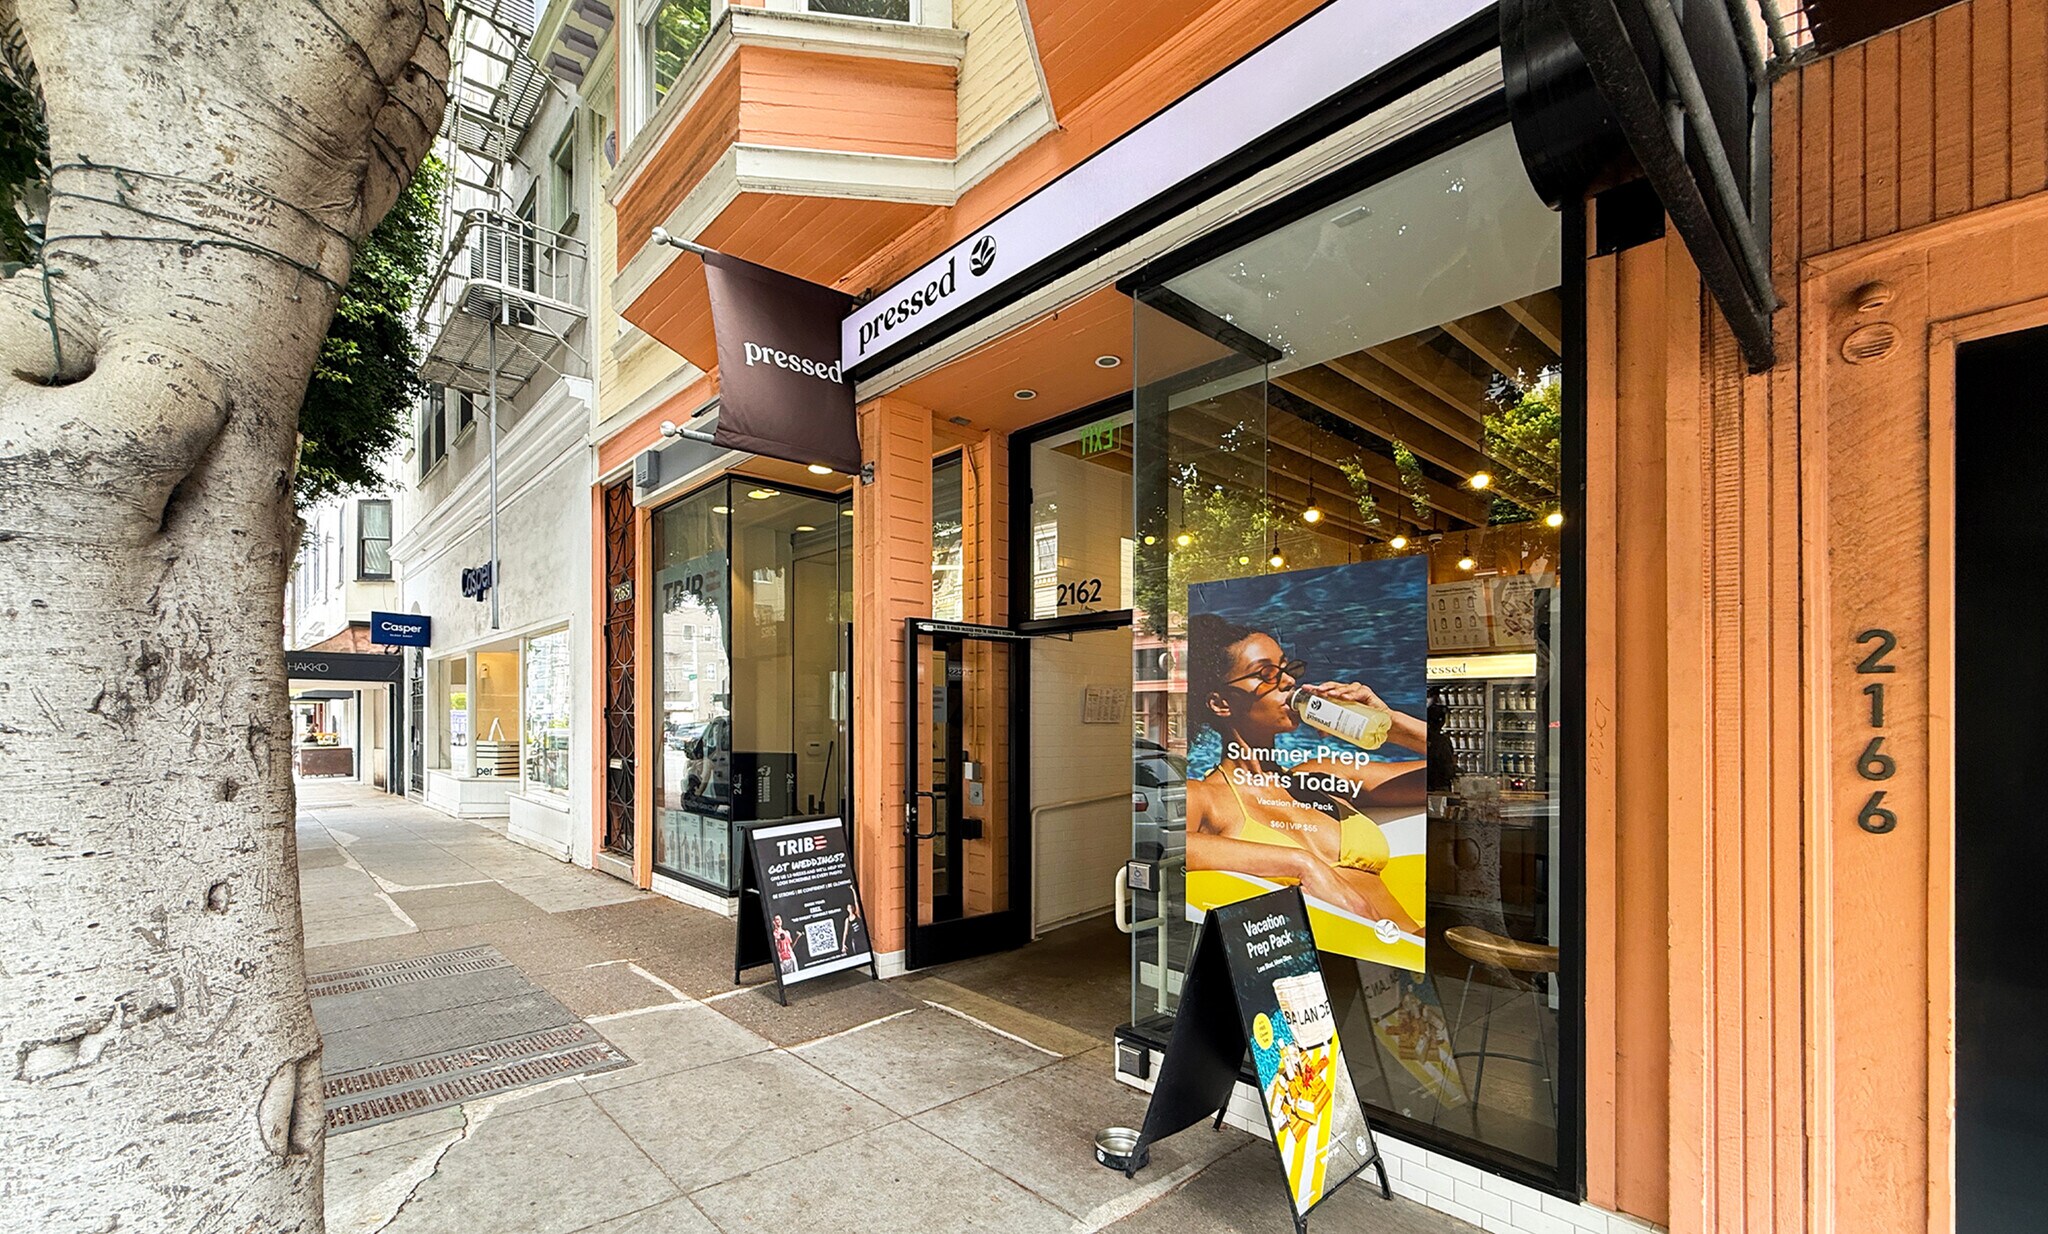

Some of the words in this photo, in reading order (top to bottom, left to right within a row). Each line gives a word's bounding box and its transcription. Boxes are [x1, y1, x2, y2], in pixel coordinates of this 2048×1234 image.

[859, 256, 956, 356] pressed
[743, 342, 843, 384] pressed
[1056, 578, 1102, 607] 2162
[381, 621, 422, 634] Casper
[287, 661, 329, 673] HAKKO
[1427, 663, 1466, 674] ressed
[1856, 628, 1898, 835] 2166
[1227, 742, 1313, 761] Summer
[1317, 745, 1370, 770] Prep
[477, 767, 493, 778] per
[1233, 767, 1292, 789] Starts
[1295, 772, 1363, 798] Today
[1256, 796, 1291, 807] Vacation
[1292, 800, 1311, 810] Prep
[1312, 801, 1334, 812] Pack
[1270, 820, 1285, 829] $60
[1290, 822, 1302, 831] VIP
[1302, 823, 1318, 832] $55
[776, 835, 827, 857] TRIBE
[768, 862, 790, 875] GOT
[791, 852, 845, 870] WEDDINGS?
[1243, 914, 1286, 937] Vacation
[1246, 941, 1270, 959] Prep
[1269, 929, 1293, 950] Pack
